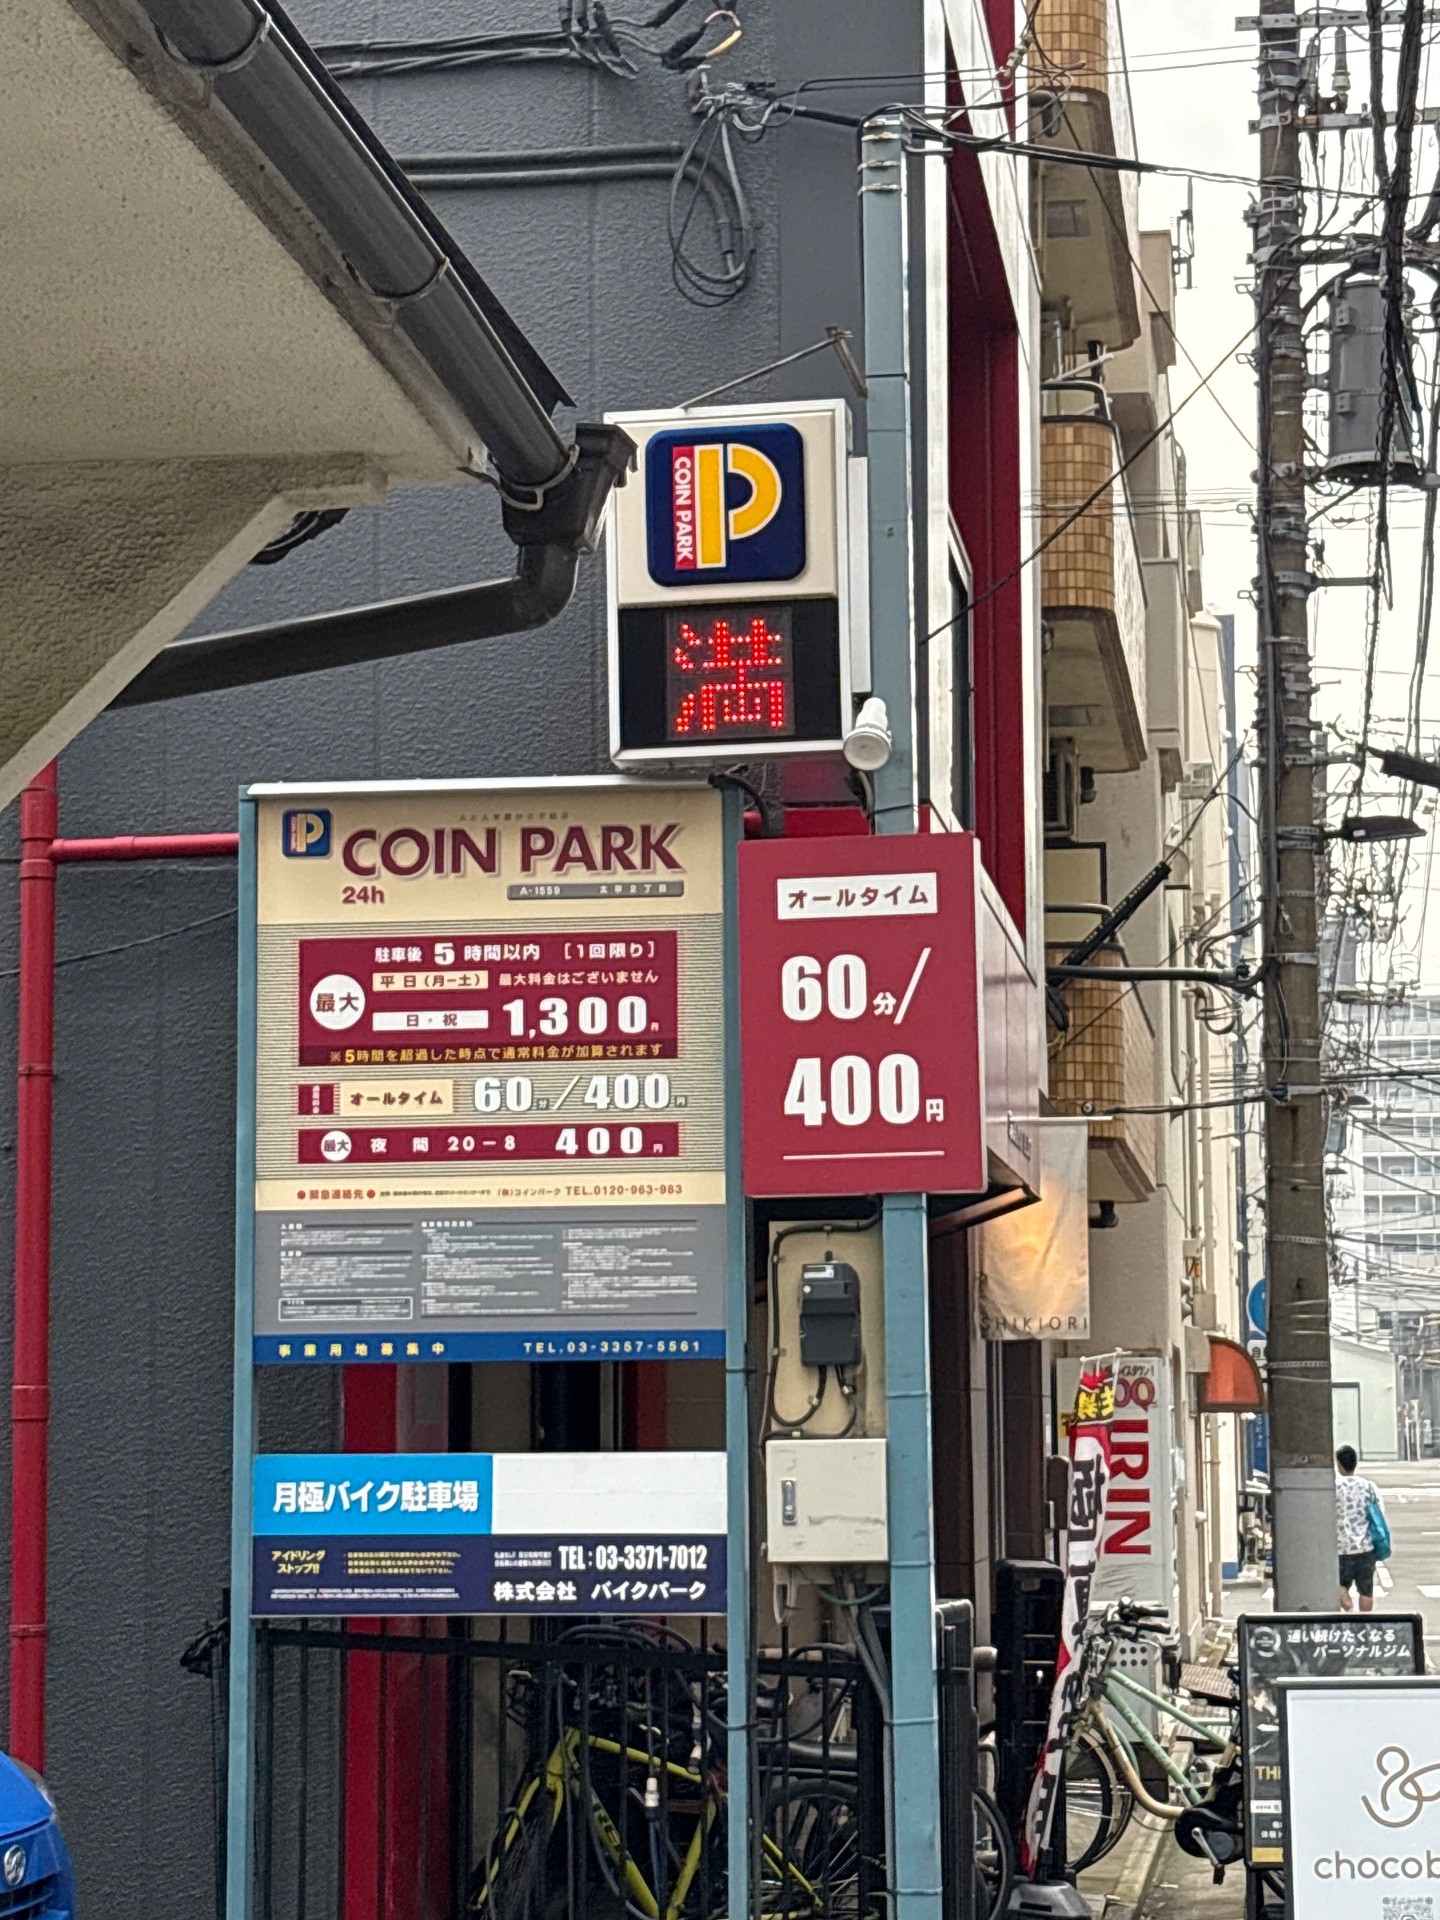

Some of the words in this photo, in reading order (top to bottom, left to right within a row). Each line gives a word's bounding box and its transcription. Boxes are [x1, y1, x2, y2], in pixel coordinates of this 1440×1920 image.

[674, 456, 691, 507] COIN
[676, 512, 694, 561] PARK
[673, 617, 784, 733] 満
[342, 827, 498, 876] COIN
[519, 823, 684, 873] PARK
[342, 887, 385, 903] 24h
[788, 885, 929, 908] オールタイム
[374, 946, 423, 963] 駐車後
[434, 942, 456, 965] 5
[463, 943, 541, 962] 時間以内
[499, 970, 659, 987] 最大料金はございません
[315, 991, 360, 1013] 最大
[350, 1090, 444, 1107] オールタイム
[323, 1138, 350, 1153] 最大
[273, 1481, 479, 1513] 月極バイク駐車場
[271, 1550, 326, 1561] アイドリング
[493, 1581, 577, 1601] 株式会社
[591, 1581, 706, 1600] バイクパーク
[1287, 1629, 1396, 1643] 通い続けたくなる
[1312, 1644, 1411, 1658] パーソナルジム
